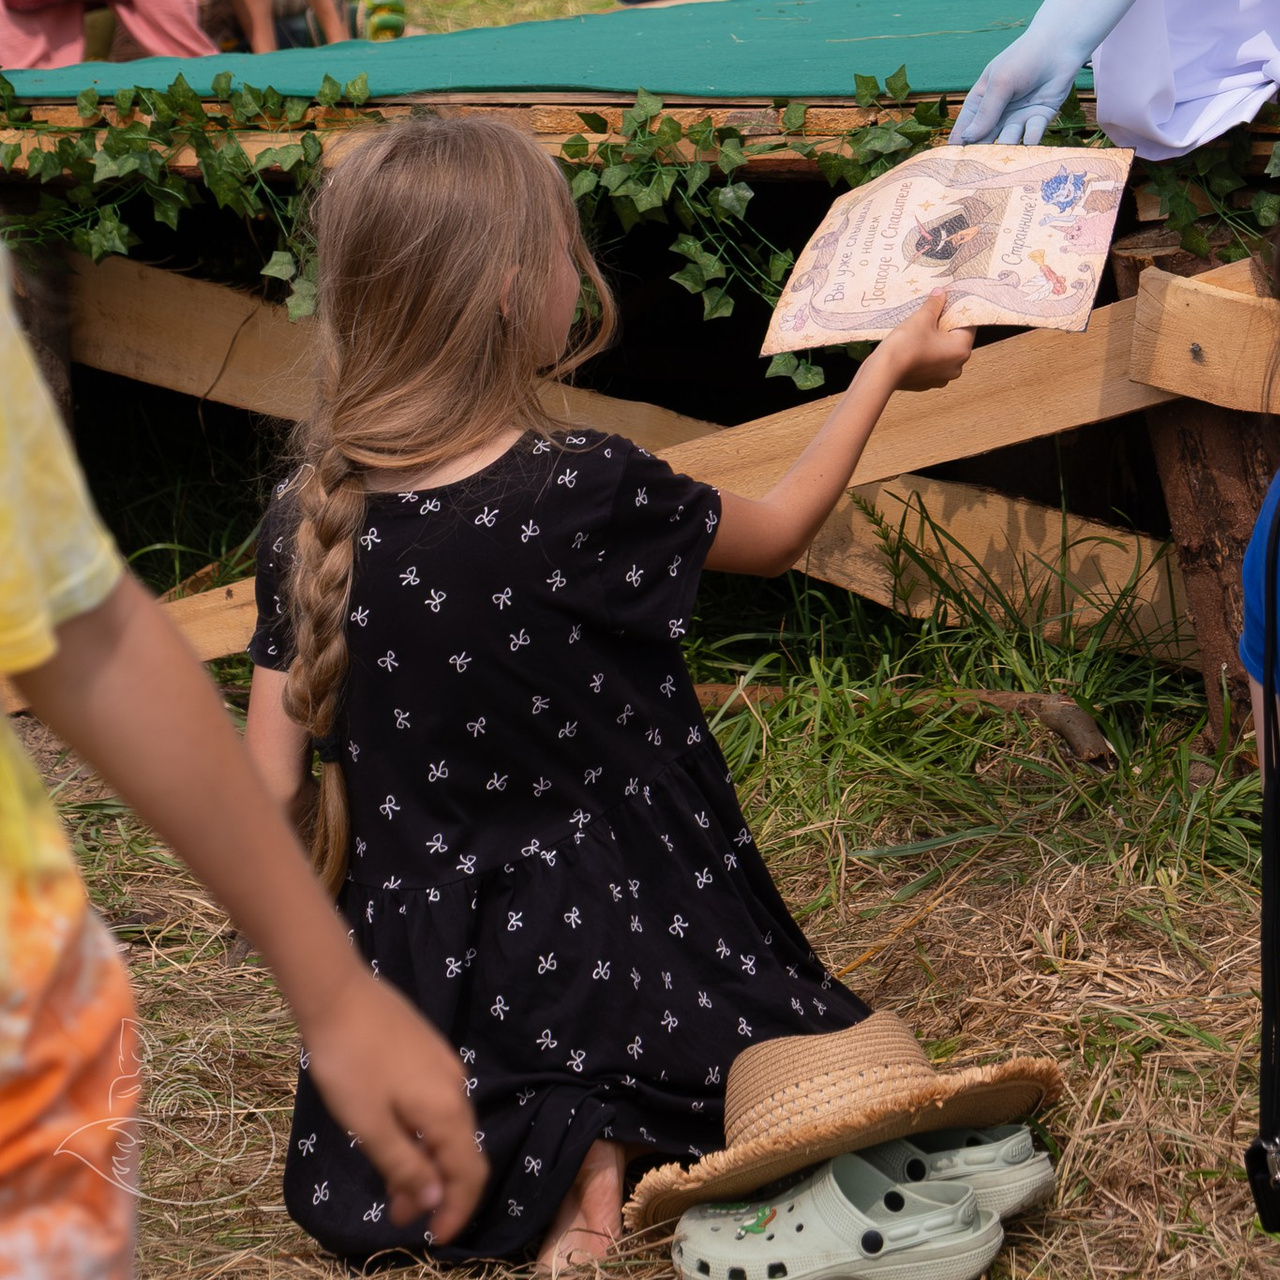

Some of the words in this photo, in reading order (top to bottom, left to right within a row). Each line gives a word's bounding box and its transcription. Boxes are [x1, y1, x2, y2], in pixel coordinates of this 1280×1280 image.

[861, 215, 882, 254] нашем
[881, 181, 912, 239] Спасителе
[1001, 194, 1038, 266] Страннике?
[824, 281, 846, 305] Вы
[836, 251, 855, 277] уже
[846, 198, 875, 248] слышали
[859, 259, 869, 267] о
[883, 243, 895, 251] и
[861, 256, 900, 308] Господе
